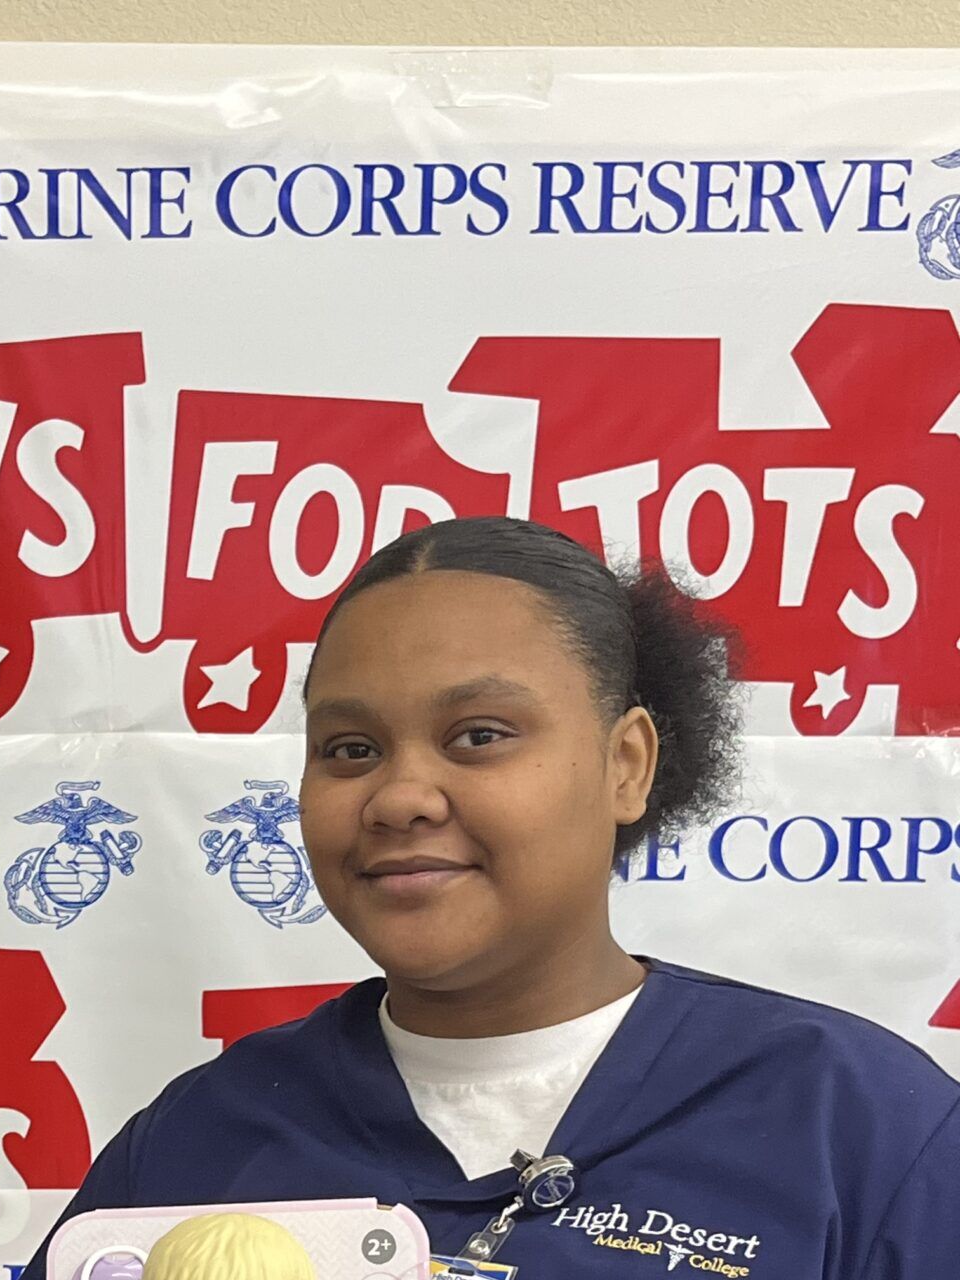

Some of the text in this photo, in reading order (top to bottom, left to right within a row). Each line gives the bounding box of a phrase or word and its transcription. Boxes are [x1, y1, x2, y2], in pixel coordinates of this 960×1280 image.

[215, 162, 509, 238] CORPS
[529, 158, 913, 237] RESERVE
[557, 458, 926, 640] TOTS
[707, 815, 960, 883] CORP
[367, 1237, 392, 1256] 2+
[551, 1203, 761, 1259] High Desert
[593, 1233, 750, 1279] Medical College
